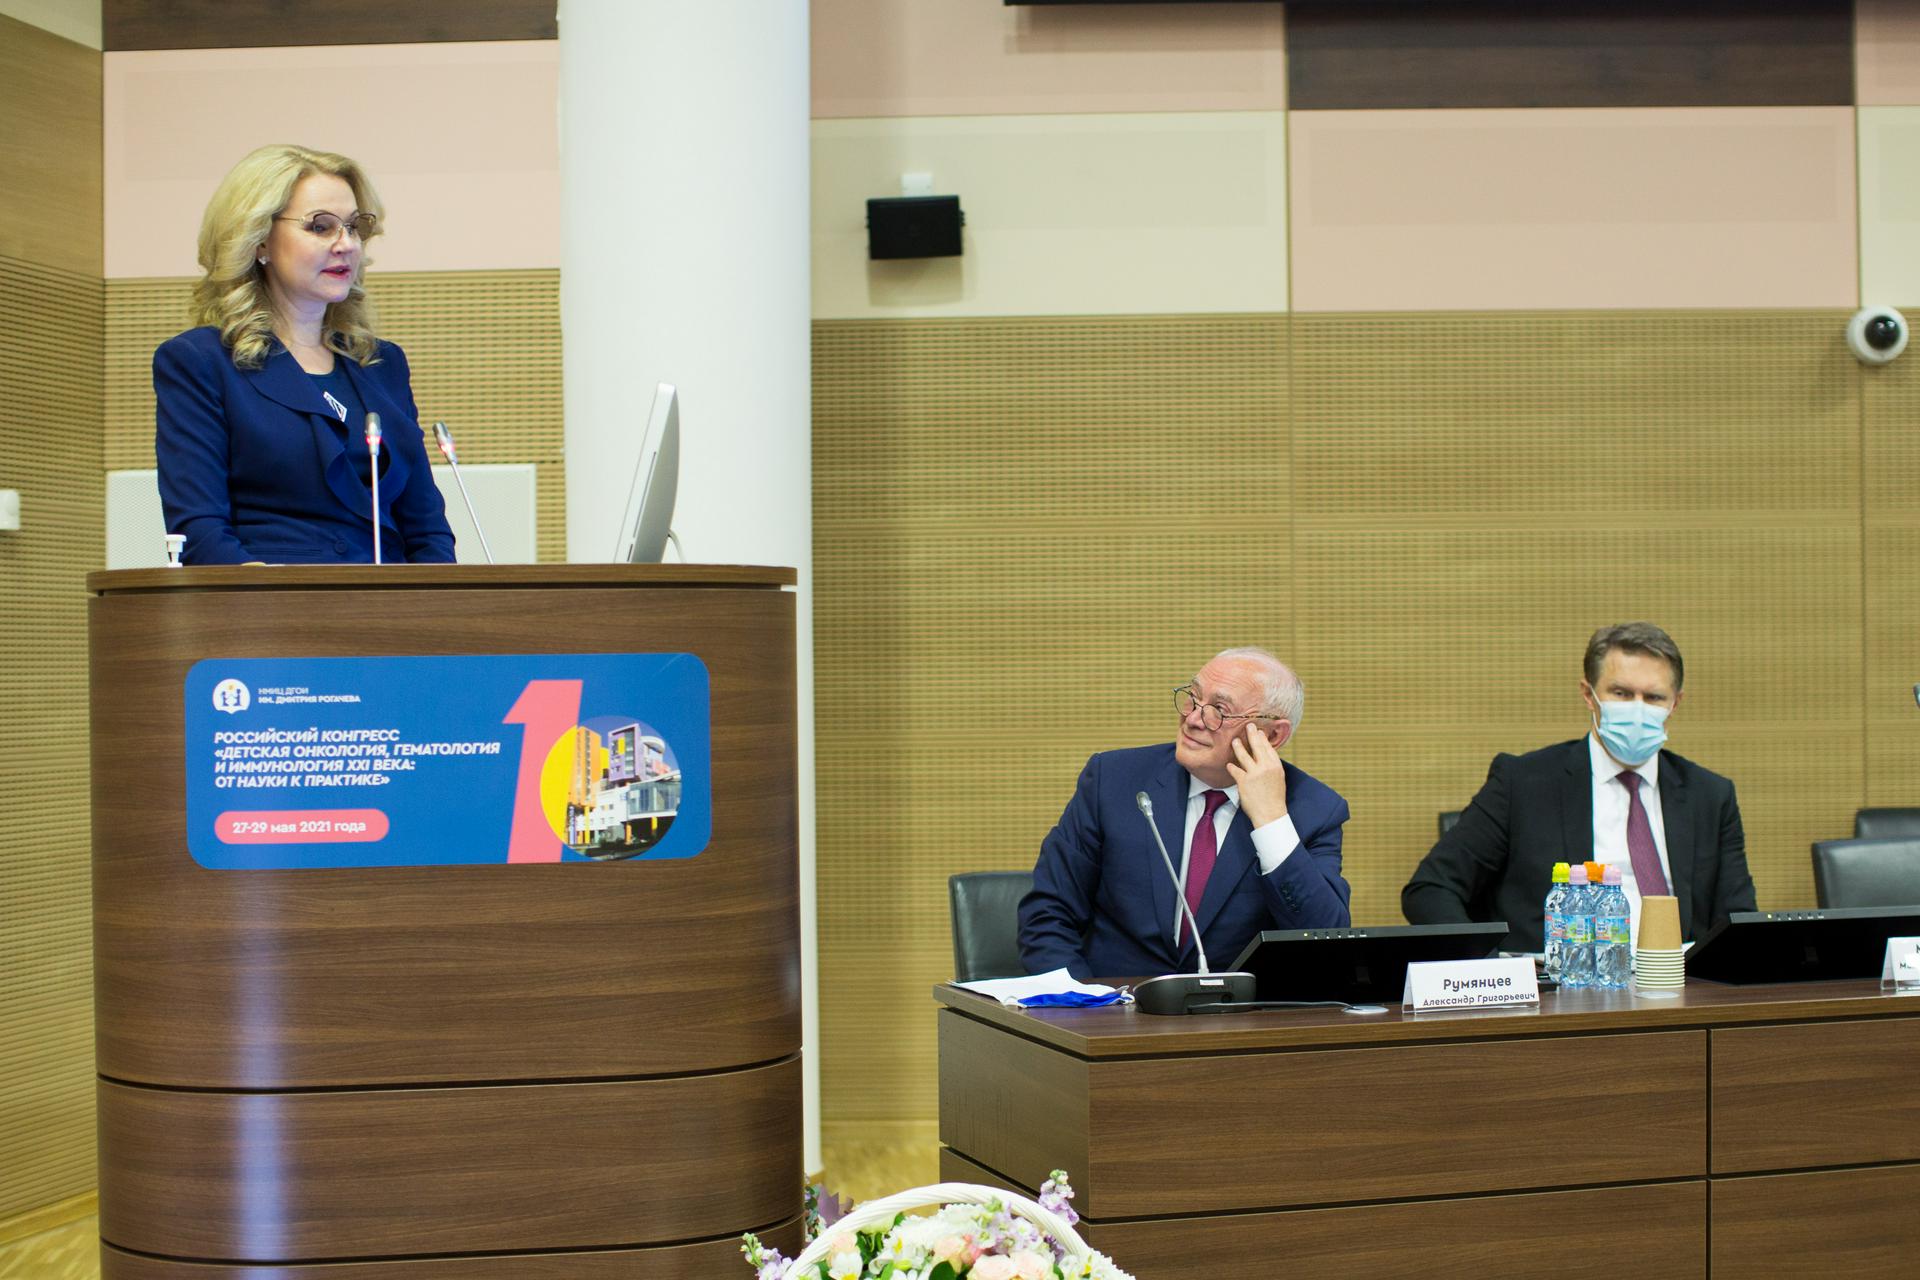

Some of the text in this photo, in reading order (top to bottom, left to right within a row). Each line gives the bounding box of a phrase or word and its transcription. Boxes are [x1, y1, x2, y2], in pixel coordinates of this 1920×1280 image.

[214, 727, 400, 744] РОССИЙСКИЙ КОНГРЕСС
[214, 742, 501, 760] «ДЕТСКАЯ ОНКОЛОГИЯ, ГЕМАТОЛОГИЯ
[215, 762, 226, 773] И
[228, 760, 345, 773] ИММУНОЛОГИЯ
[373, 759, 416, 771] ВЕКА:
[215, 774, 390, 788] ОТ НАУКИ К ПРАКТИКЕ»
[232, 821, 367, 834] 27-29 мая 2021 года
[1443, 977, 1512, 993] Румянцев
[1422, 992, 1536, 1007] Александр Григорьевич
